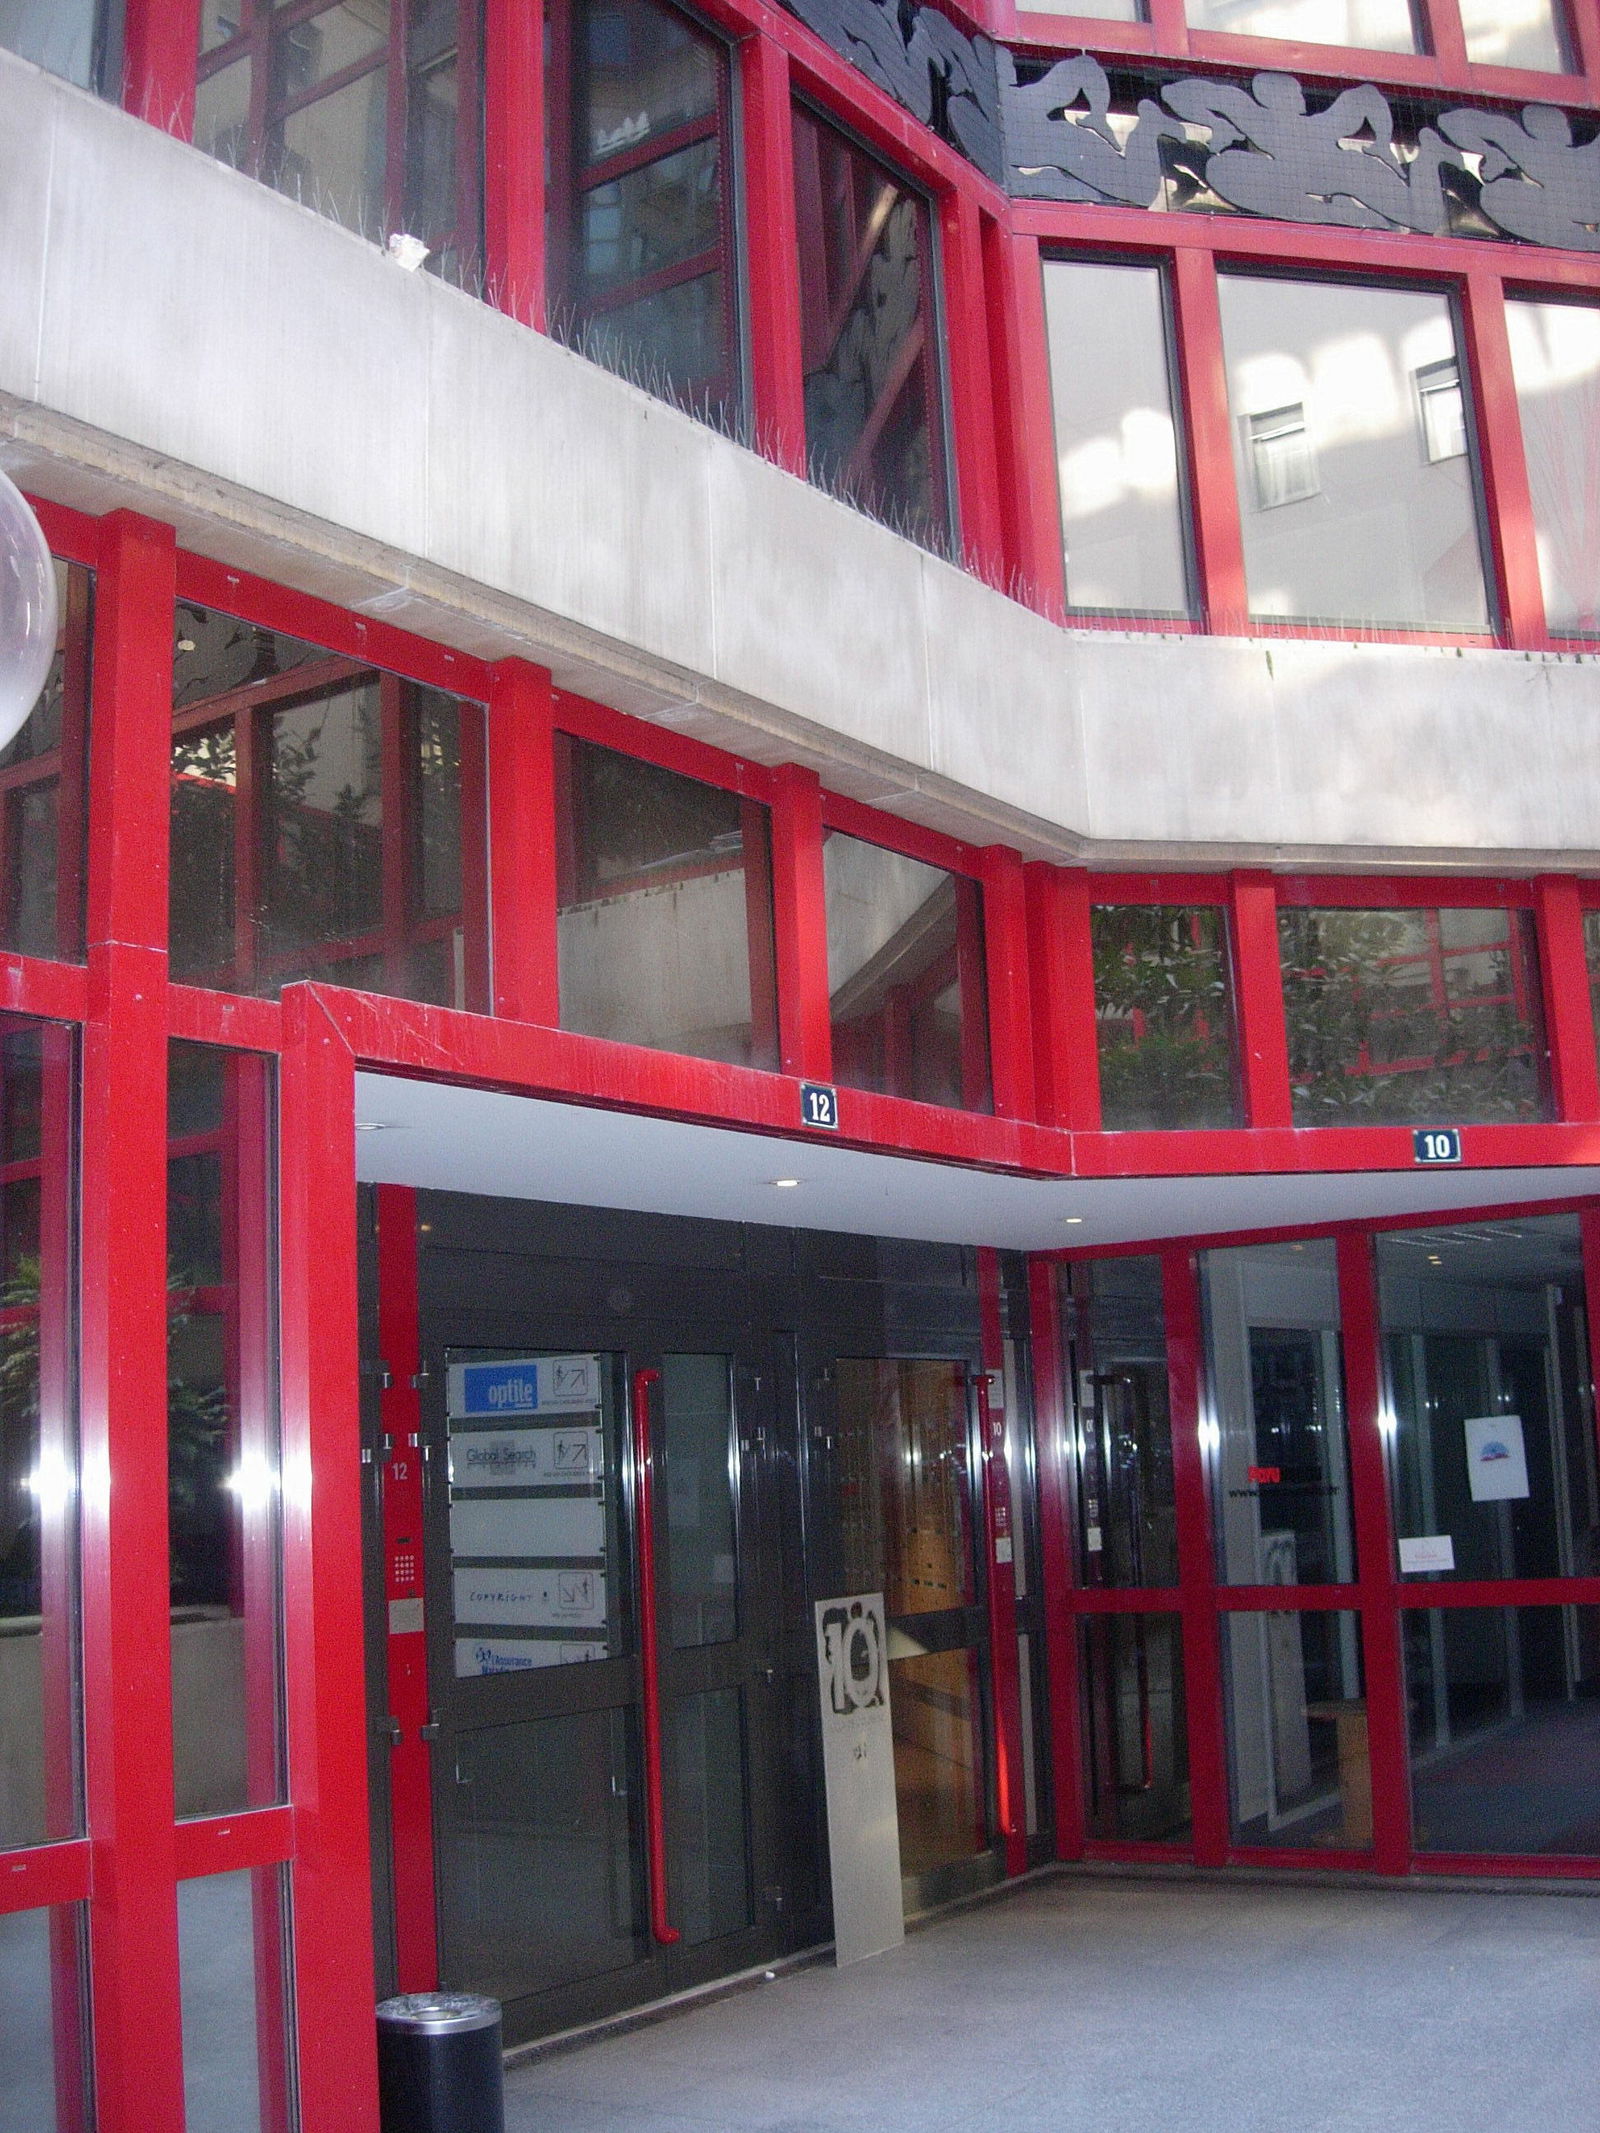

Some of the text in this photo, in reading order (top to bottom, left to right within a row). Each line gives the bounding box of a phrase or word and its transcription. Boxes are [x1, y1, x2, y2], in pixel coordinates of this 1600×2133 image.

[809, 1092, 831, 1123] 12
[1424, 1134, 1450, 1158] 10
[488, 1378, 534, 1407] optile
[992, 1421, 1003, 1437] 10
[466, 1445, 537, 1462] Global Search
[391, 1462, 409, 1481] 12
[824, 1613, 880, 1712] 10
